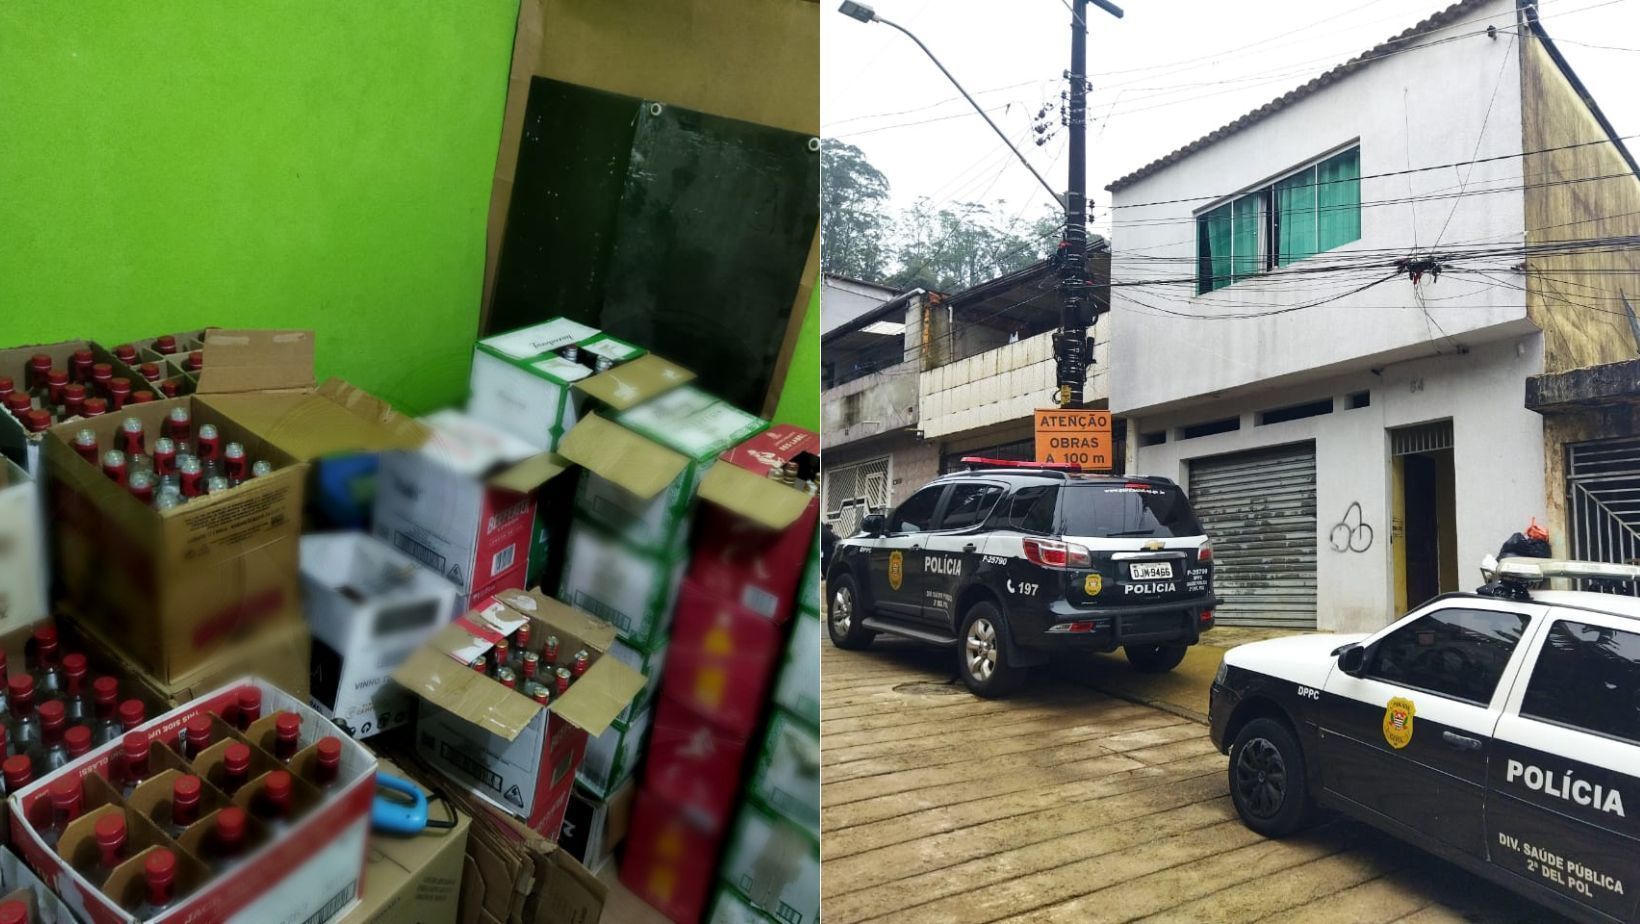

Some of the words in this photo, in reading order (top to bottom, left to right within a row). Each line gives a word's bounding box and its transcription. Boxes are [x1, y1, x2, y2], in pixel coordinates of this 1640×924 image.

[1040, 413, 1107, 429] ATENÇÃO
[1050, 437, 1099, 448] OBRAS
[1046, 453, 1055, 463] A
[1063, 452, 1089, 464] 100
[1093, 454, 1105, 463] m
[924, 554, 962, 576] POLÍCIA
[1018, 582, 1039, 596] 197
[1124, 582, 1176, 594] POLÍCIA
[1297, 686, 1320, 700] DPPC
[1506, 759, 1625, 817] POLÍCIA
[1499, 832, 1521, 852] DIV.
[1523, 843, 1564, 870] SAÚDE
[1567, 860, 1624, 895] PÚBLICA
[1541, 865, 1565, 885] DEL
[1567, 876, 1593, 898] POL
